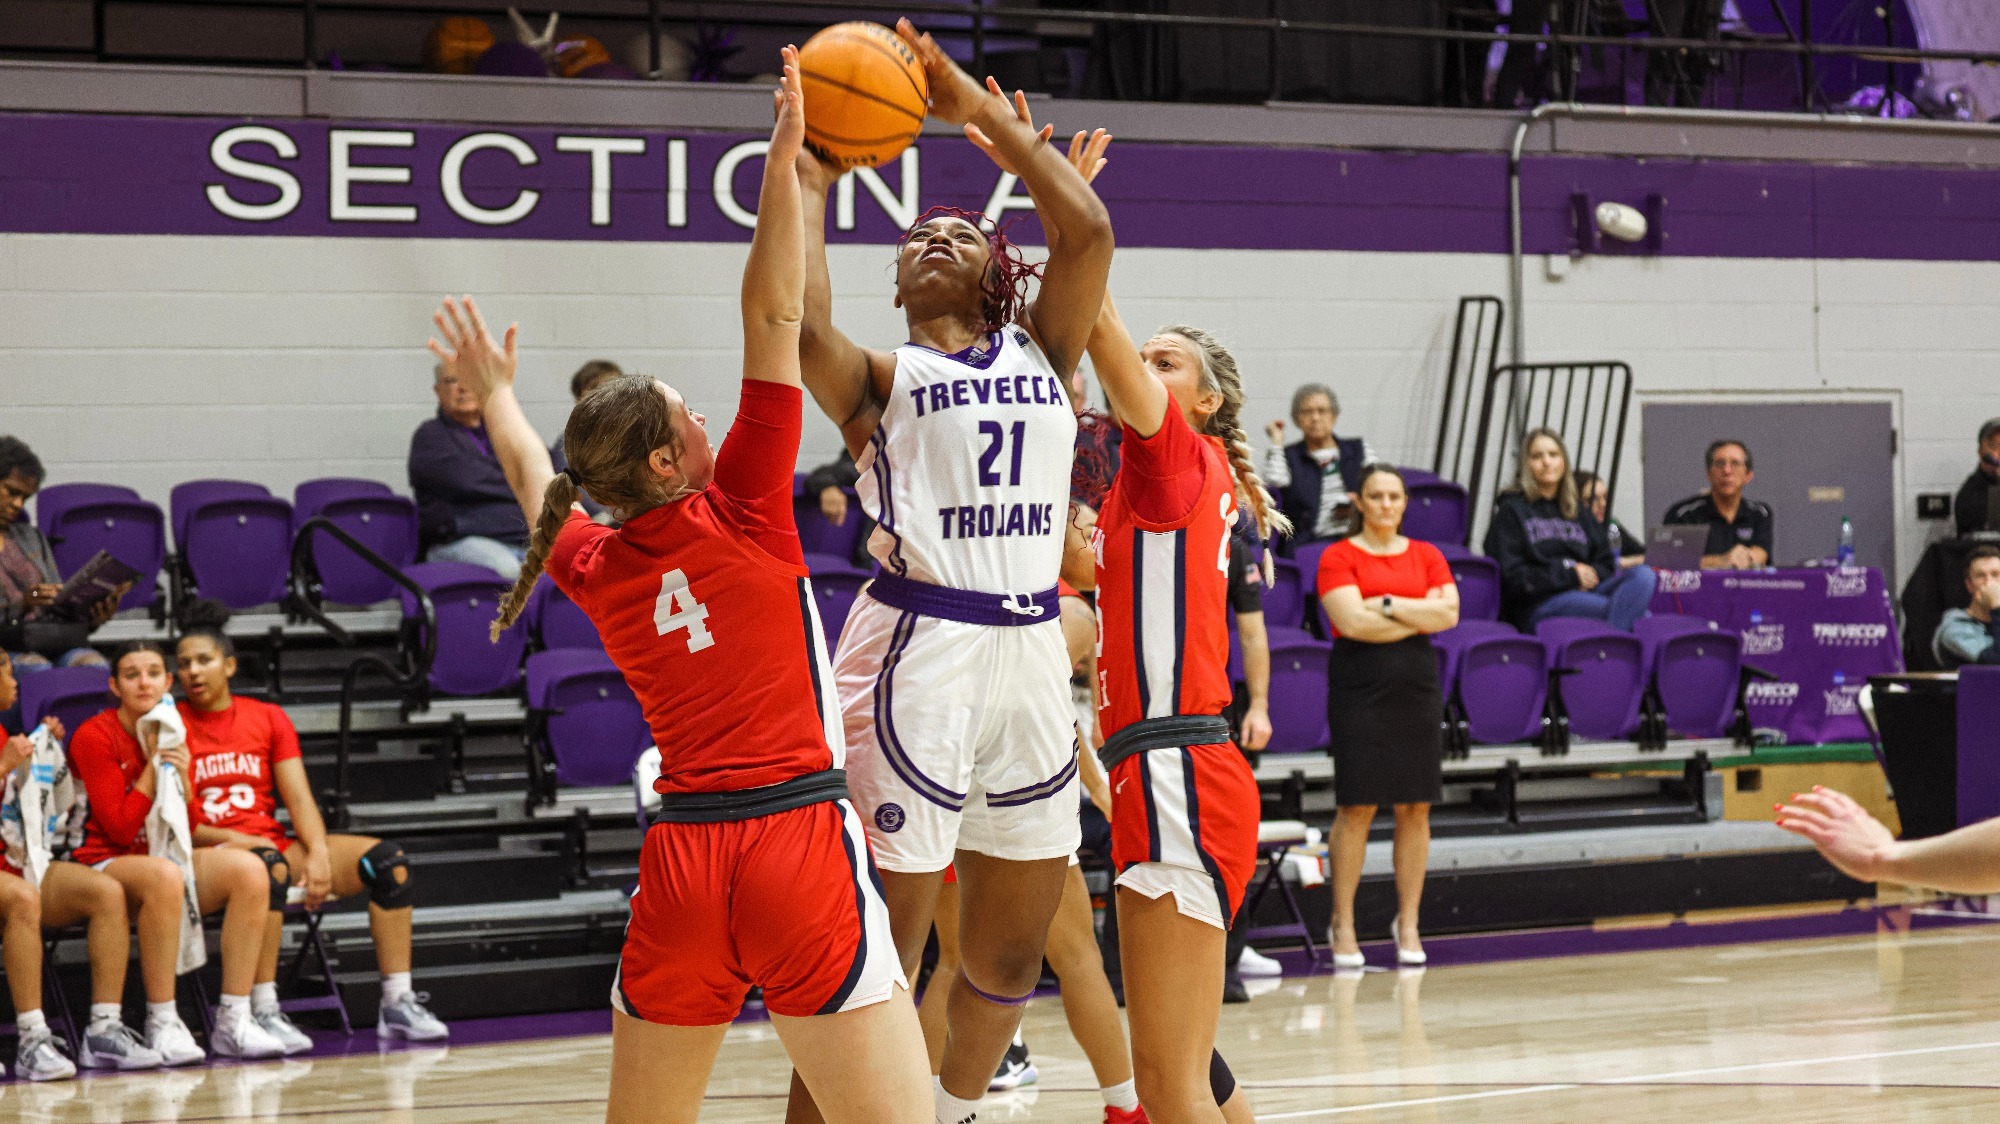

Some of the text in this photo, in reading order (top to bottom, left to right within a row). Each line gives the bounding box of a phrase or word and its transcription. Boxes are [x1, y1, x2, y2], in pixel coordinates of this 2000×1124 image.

[910, 375, 1063, 418] TREVECCA
[978, 420, 1026, 487] 21
[938, 503, 1053, 539] TROJANS
[653, 567, 716, 655] 4
